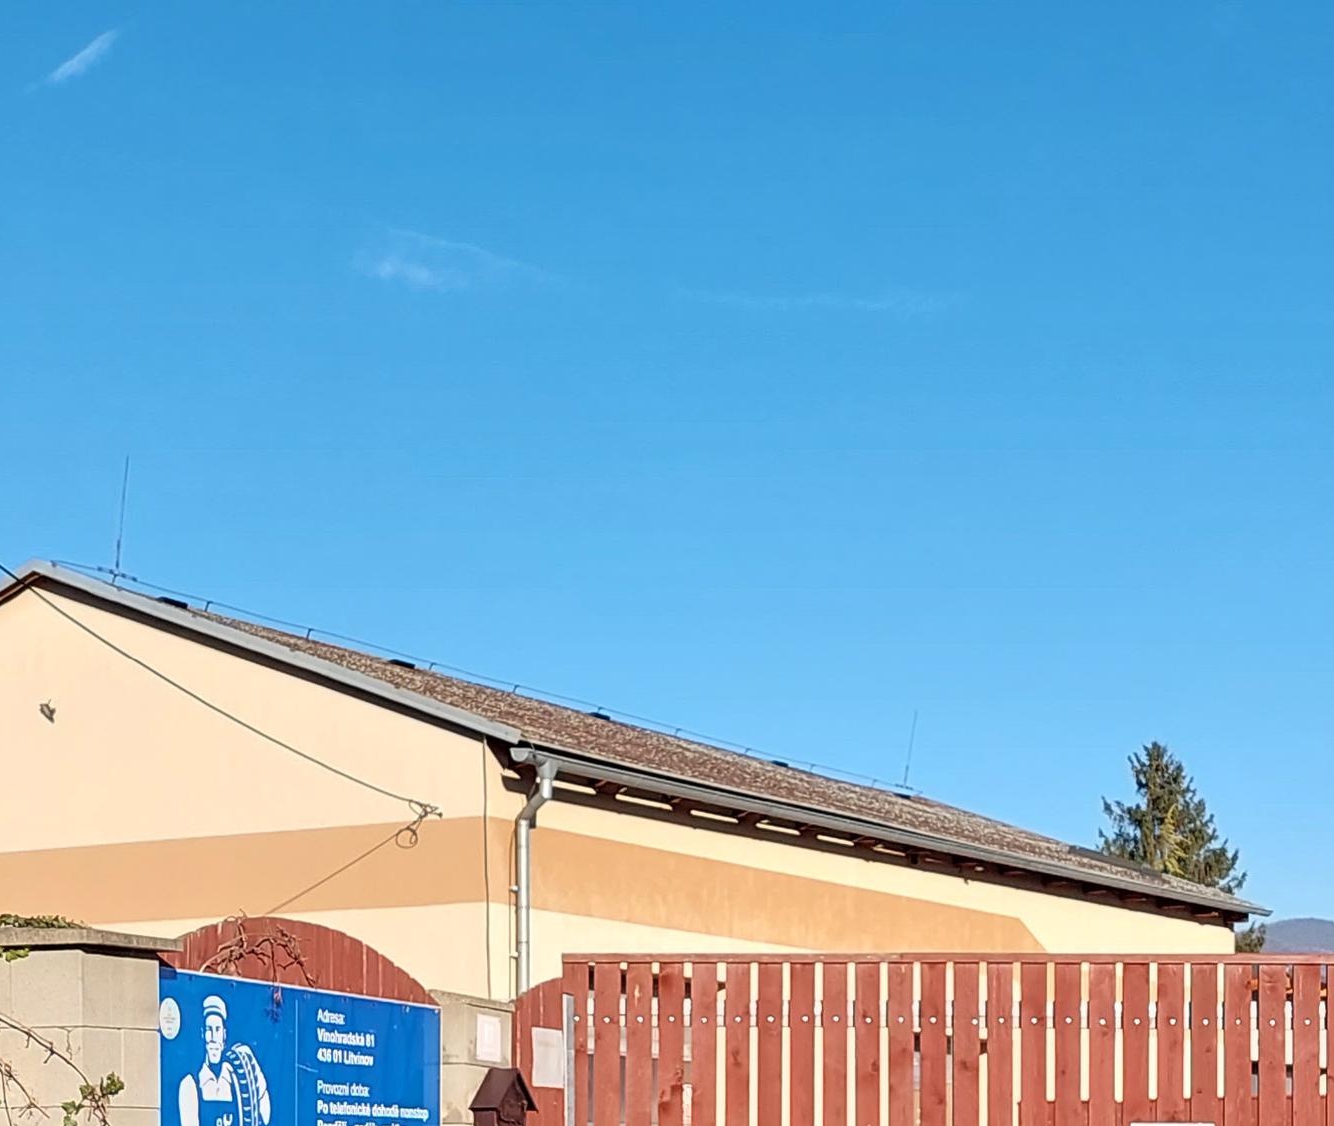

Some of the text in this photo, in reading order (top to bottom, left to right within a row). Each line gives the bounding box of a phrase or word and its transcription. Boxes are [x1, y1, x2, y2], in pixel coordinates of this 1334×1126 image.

[317, 1008, 345, 1025] Adresa:
[317, 1027, 375, 1048] Vinohradská 81
[317, 1048, 332, 1063] 436
[333, 1049, 342, 1063] 01
[317, 1080, 370, 1097] Provozní doba:
[317, 1100, 429, 1122] Po telefonické dohodě nonstop
